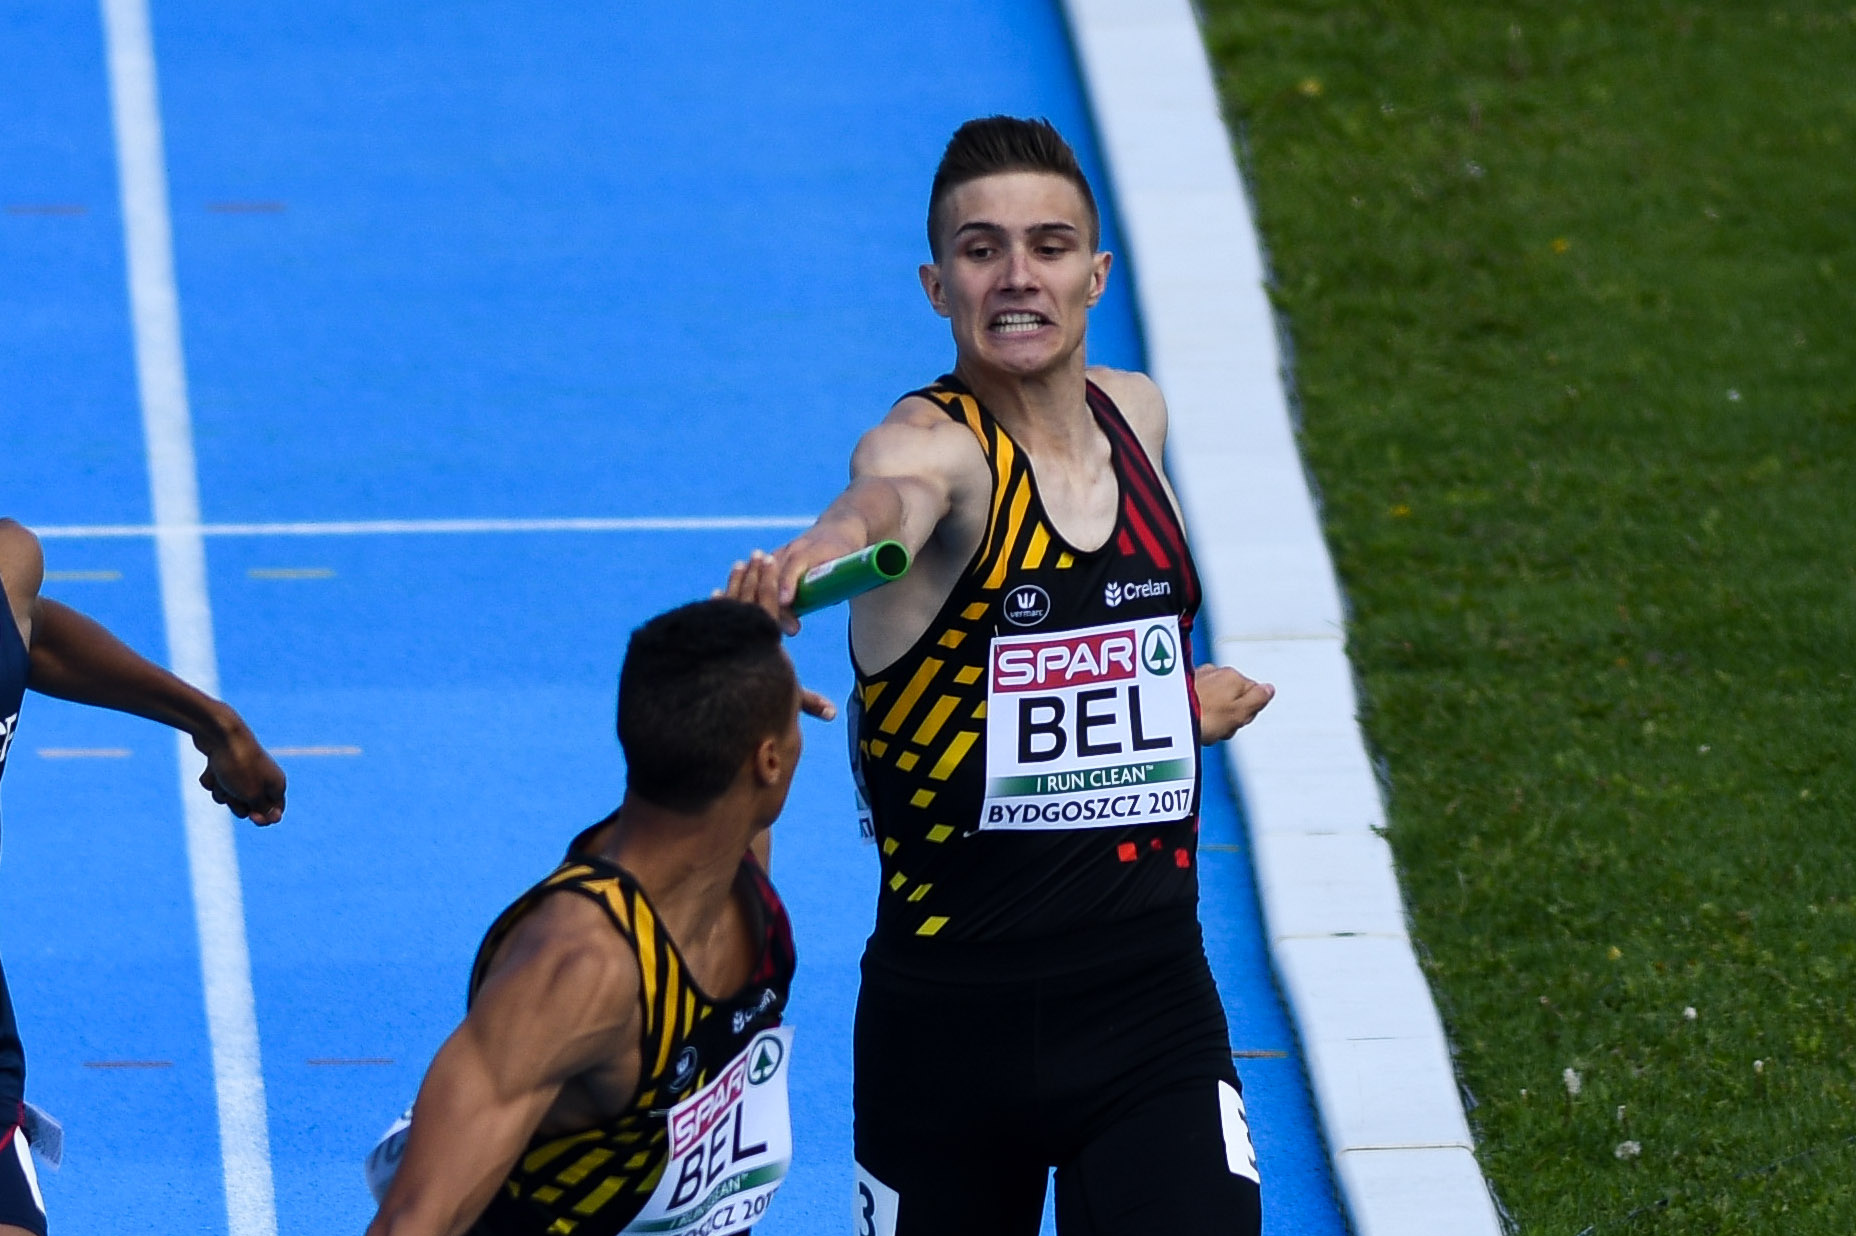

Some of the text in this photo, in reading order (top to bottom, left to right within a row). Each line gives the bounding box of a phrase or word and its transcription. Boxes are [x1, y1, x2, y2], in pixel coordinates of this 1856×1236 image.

[1123, 579, 1171, 600] Crelan
[997, 636, 1134, 687] SPAR
[1017, 684, 1173, 764] BEL
[988, 788, 1191, 824] BYDGOSZCZ 2017
[1036, 777, 1042, 793] I
[1047, 772, 1085, 792] RUN
[674, 1065, 746, 1154] SPAR
[666, 1102, 768, 1211] BEL
